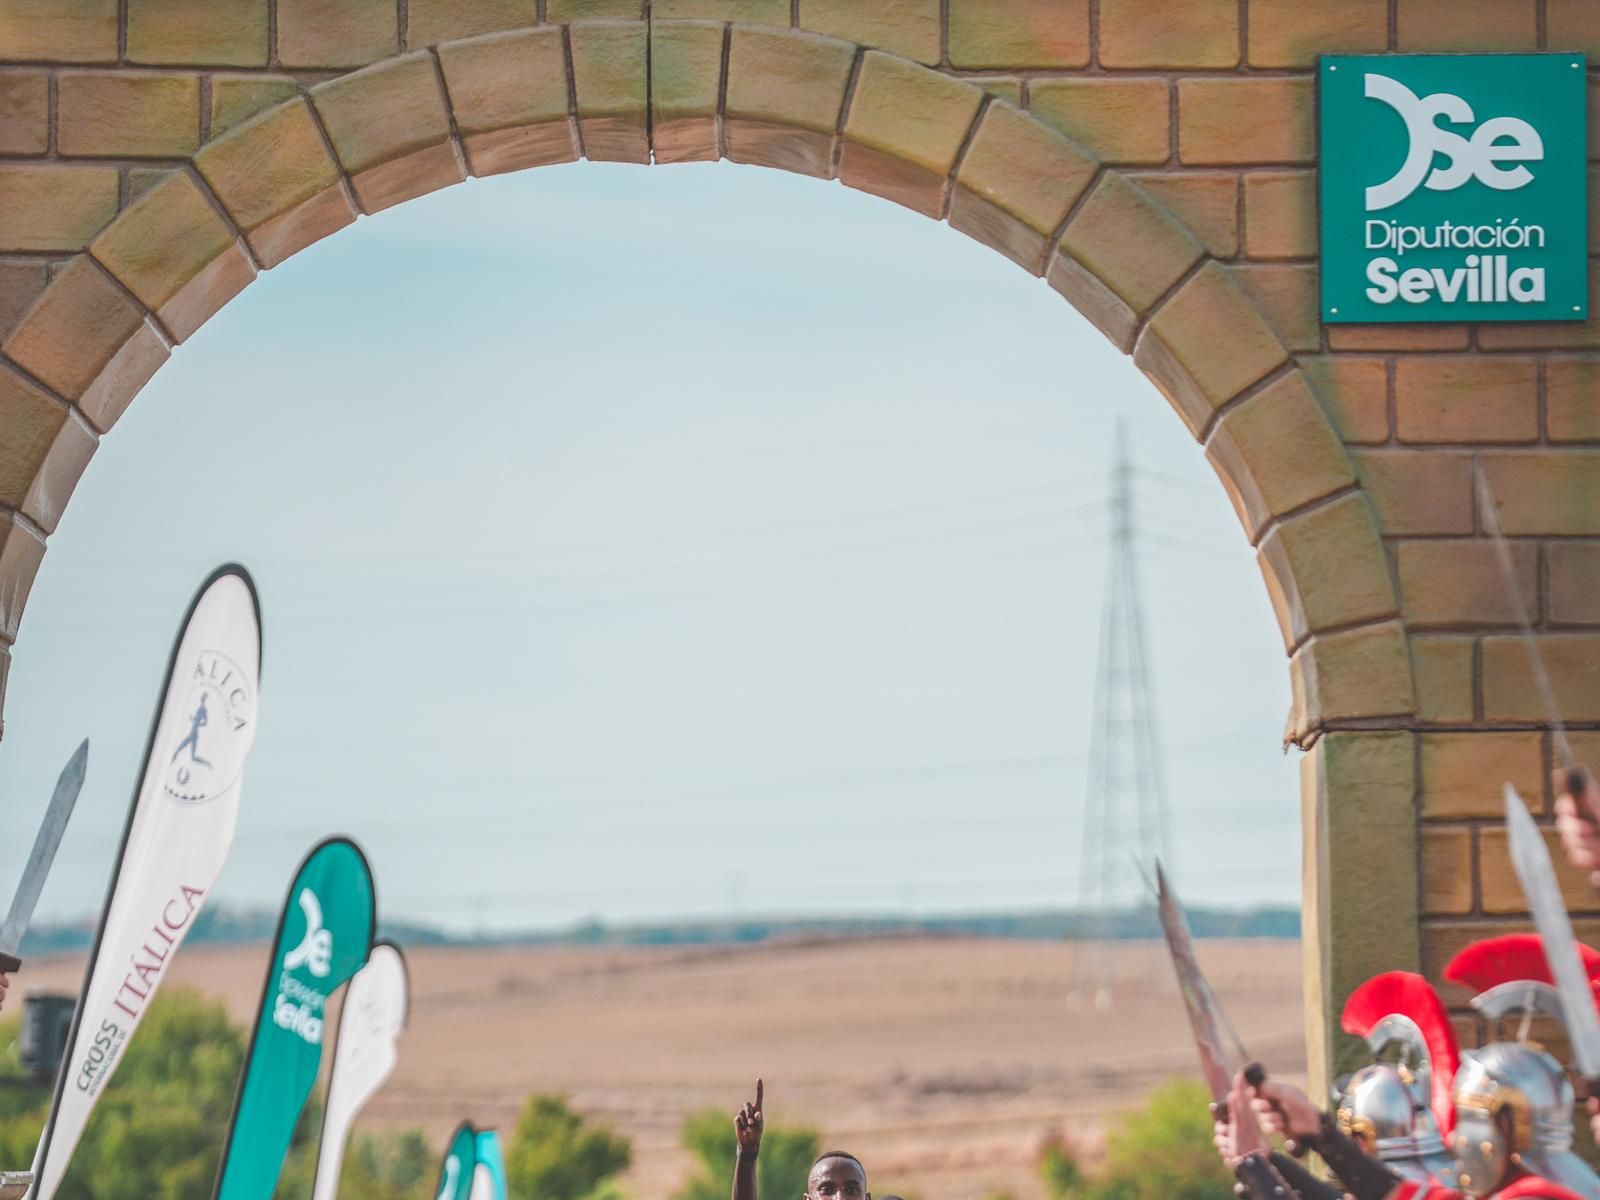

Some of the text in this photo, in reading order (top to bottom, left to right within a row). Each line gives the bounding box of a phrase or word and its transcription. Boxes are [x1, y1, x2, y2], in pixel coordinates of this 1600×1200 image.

[1365, 217, 1545, 255] Diputación
[1366, 254, 1546, 304] Sevilla
[113, 884, 205, 1020] ITÁLICA
[76, 1018, 119, 1092] CROSS
